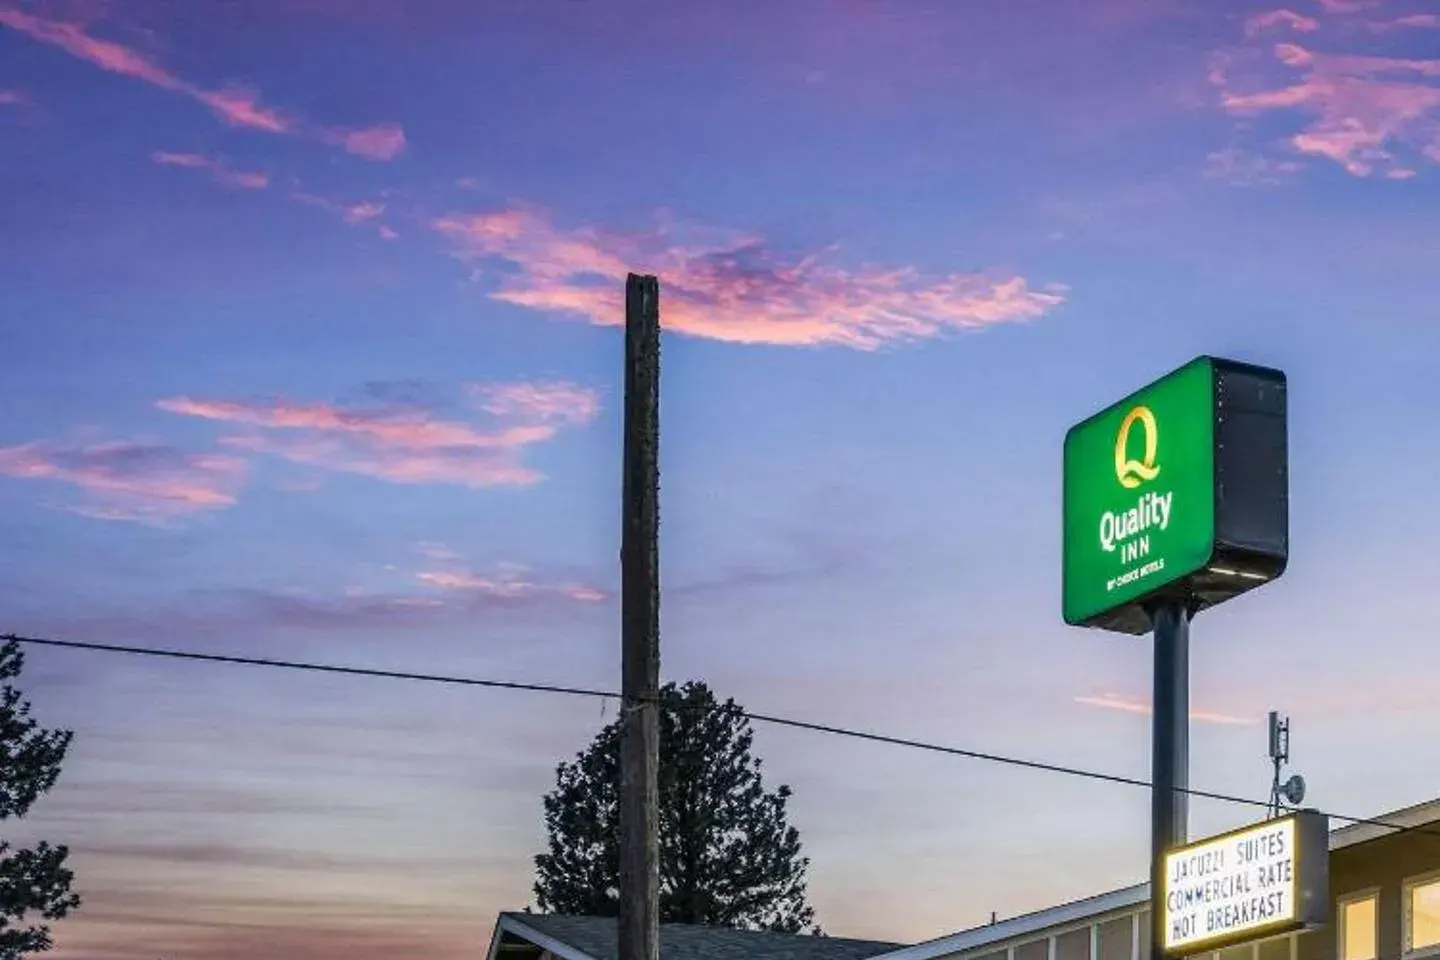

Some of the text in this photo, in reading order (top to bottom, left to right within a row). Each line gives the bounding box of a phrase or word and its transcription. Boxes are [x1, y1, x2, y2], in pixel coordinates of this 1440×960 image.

[1115, 405, 1160, 488] Q
[1100, 492, 1173, 552] Quality
[1121, 535, 1150, 564] INN
[1174, 831, 1284, 883] JACUZZI SUITES
[1167, 859, 1291, 913] COMMERCIAL RATE
[1172, 892, 1283, 940] HOT BREAKFAST
